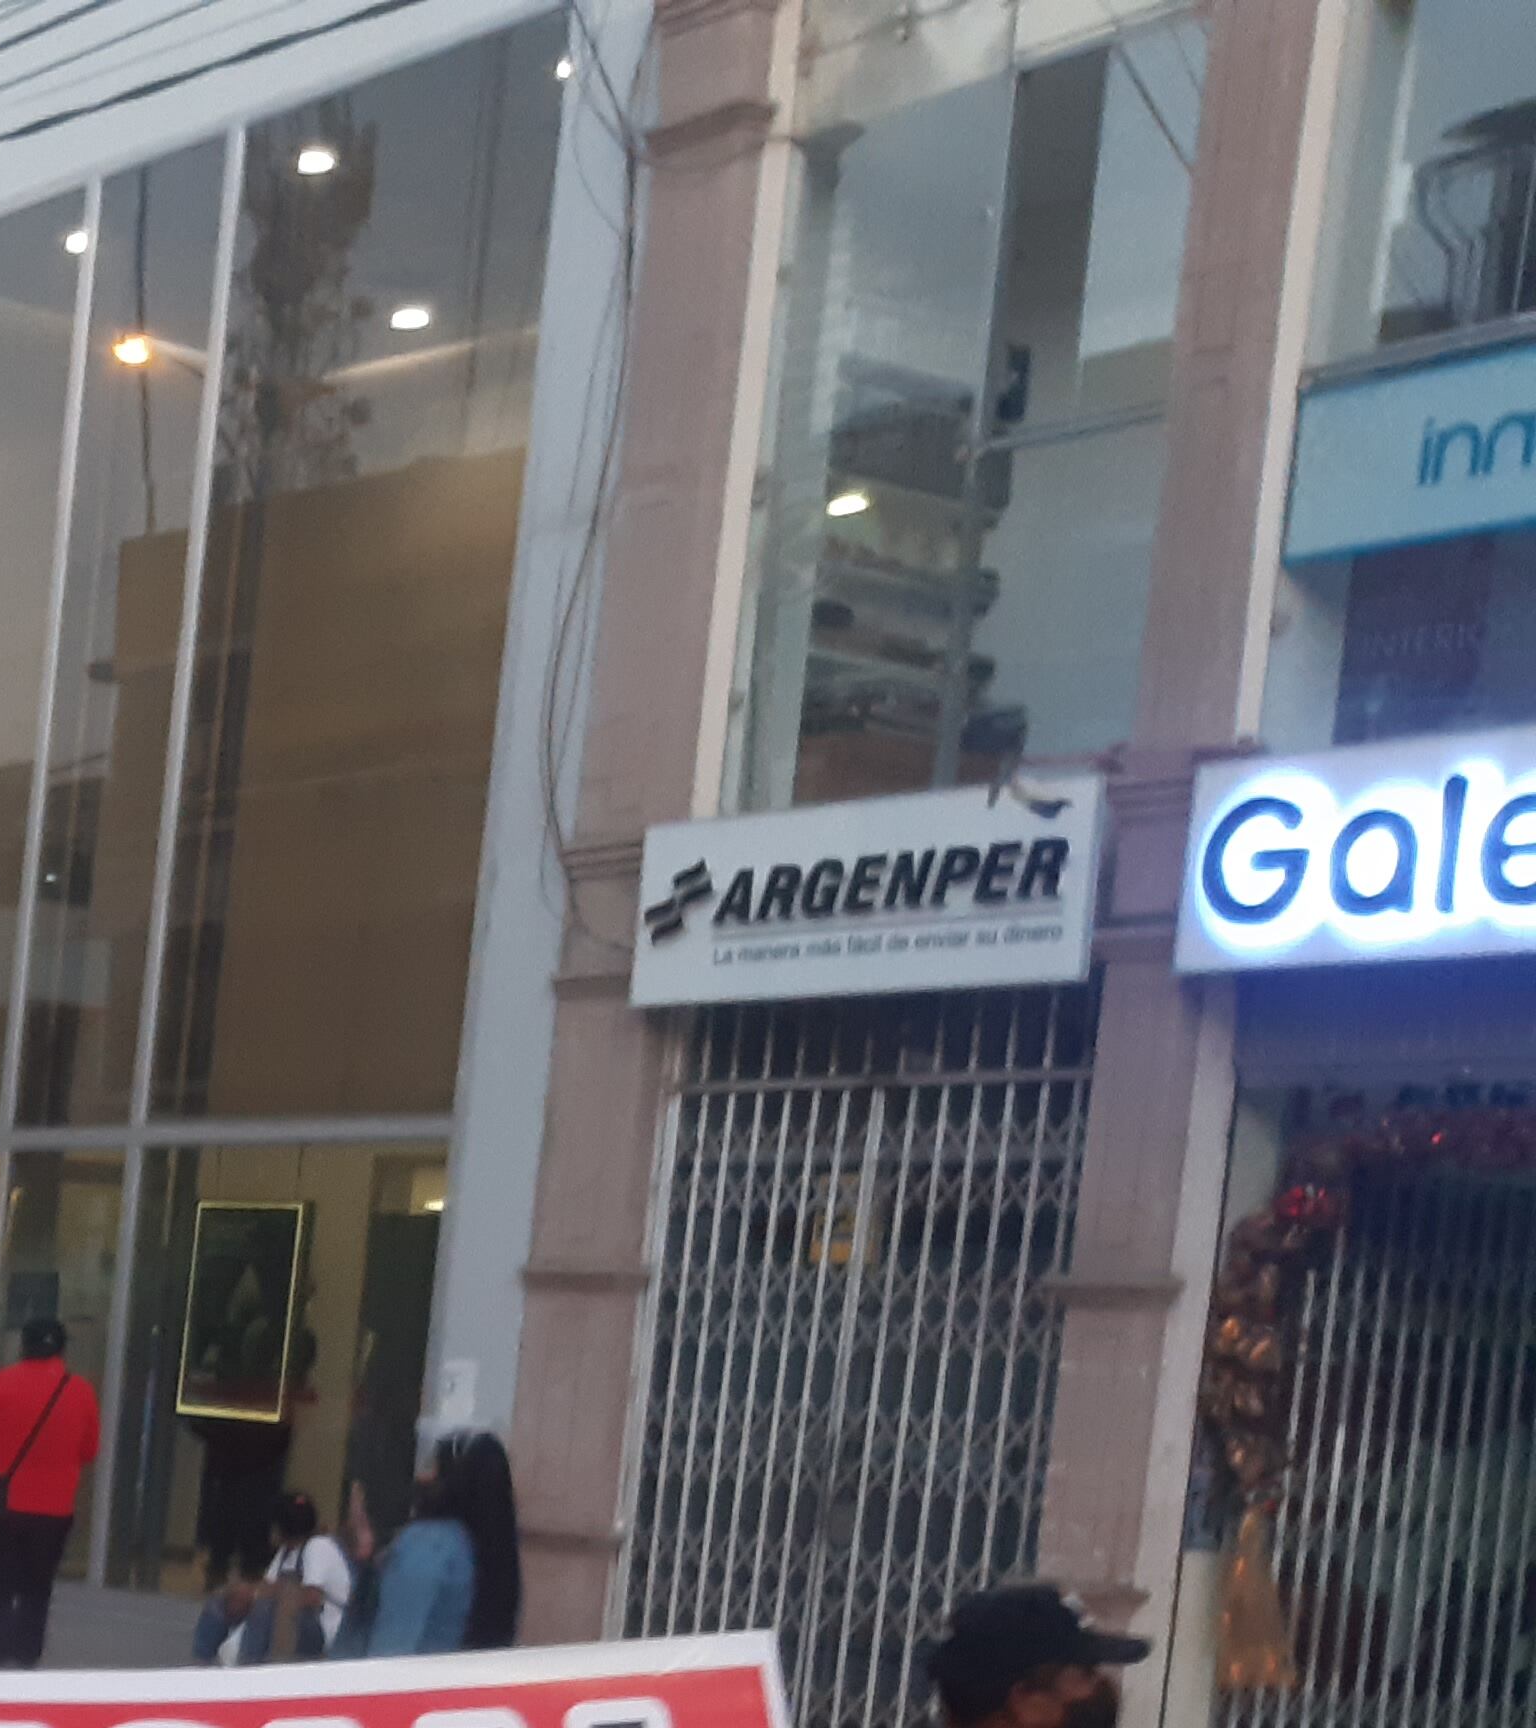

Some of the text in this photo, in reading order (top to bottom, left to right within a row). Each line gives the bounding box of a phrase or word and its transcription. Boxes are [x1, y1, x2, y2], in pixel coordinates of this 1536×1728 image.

[713, 836, 1070, 928] ARGENPER
[713, 948, 733, 966] La
[737, 942, 800, 962] manera
[888, 933, 909, 952] de
[914, 929, 969, 949] enviar
[975, 929, 998, 946] su
[1003, 924, 1063, 945] dinero
